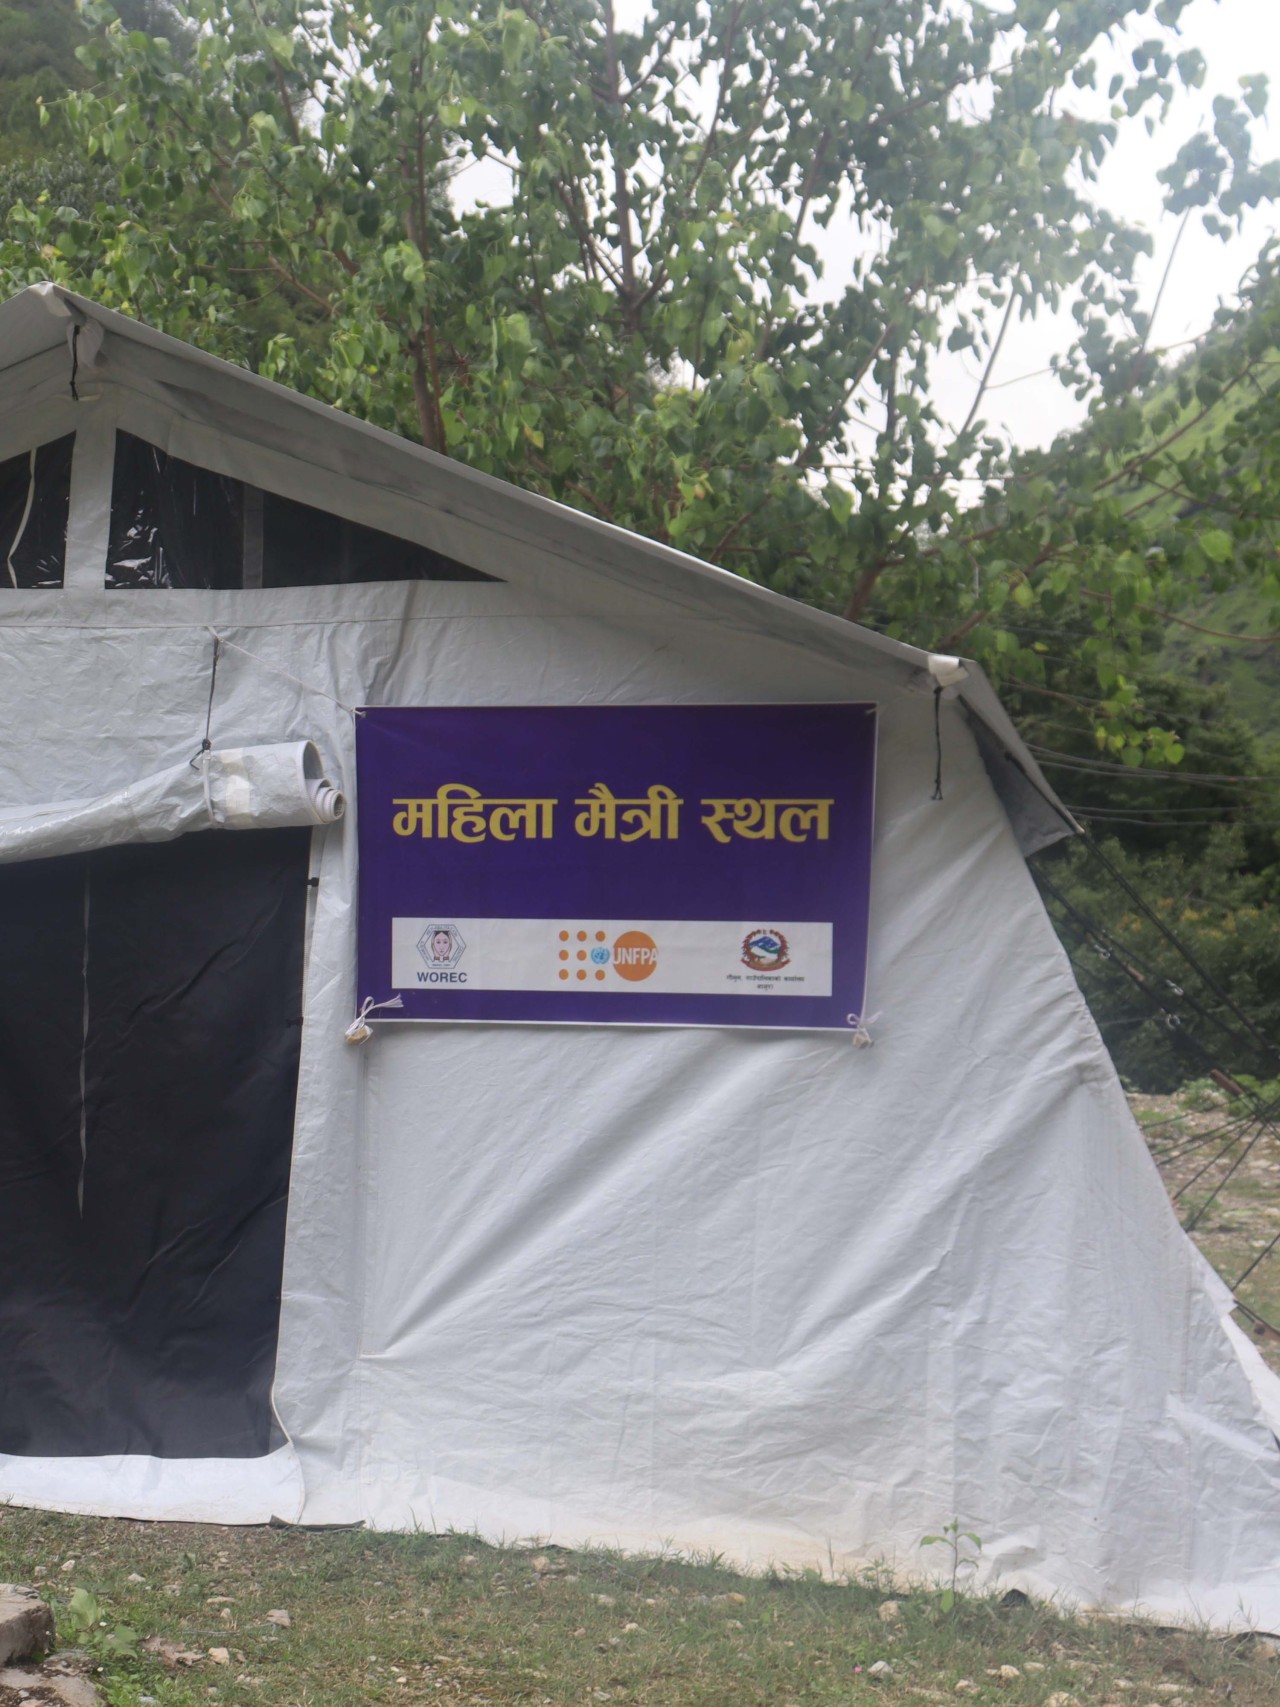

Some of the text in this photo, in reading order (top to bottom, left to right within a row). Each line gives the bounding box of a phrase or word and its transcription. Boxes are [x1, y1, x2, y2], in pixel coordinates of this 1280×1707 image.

[391, 783, 834, 843] महिला मैत्री स्थल
[613, 947, 658, 965] UNFPA
[417, 972, 468, 983] WOREC
